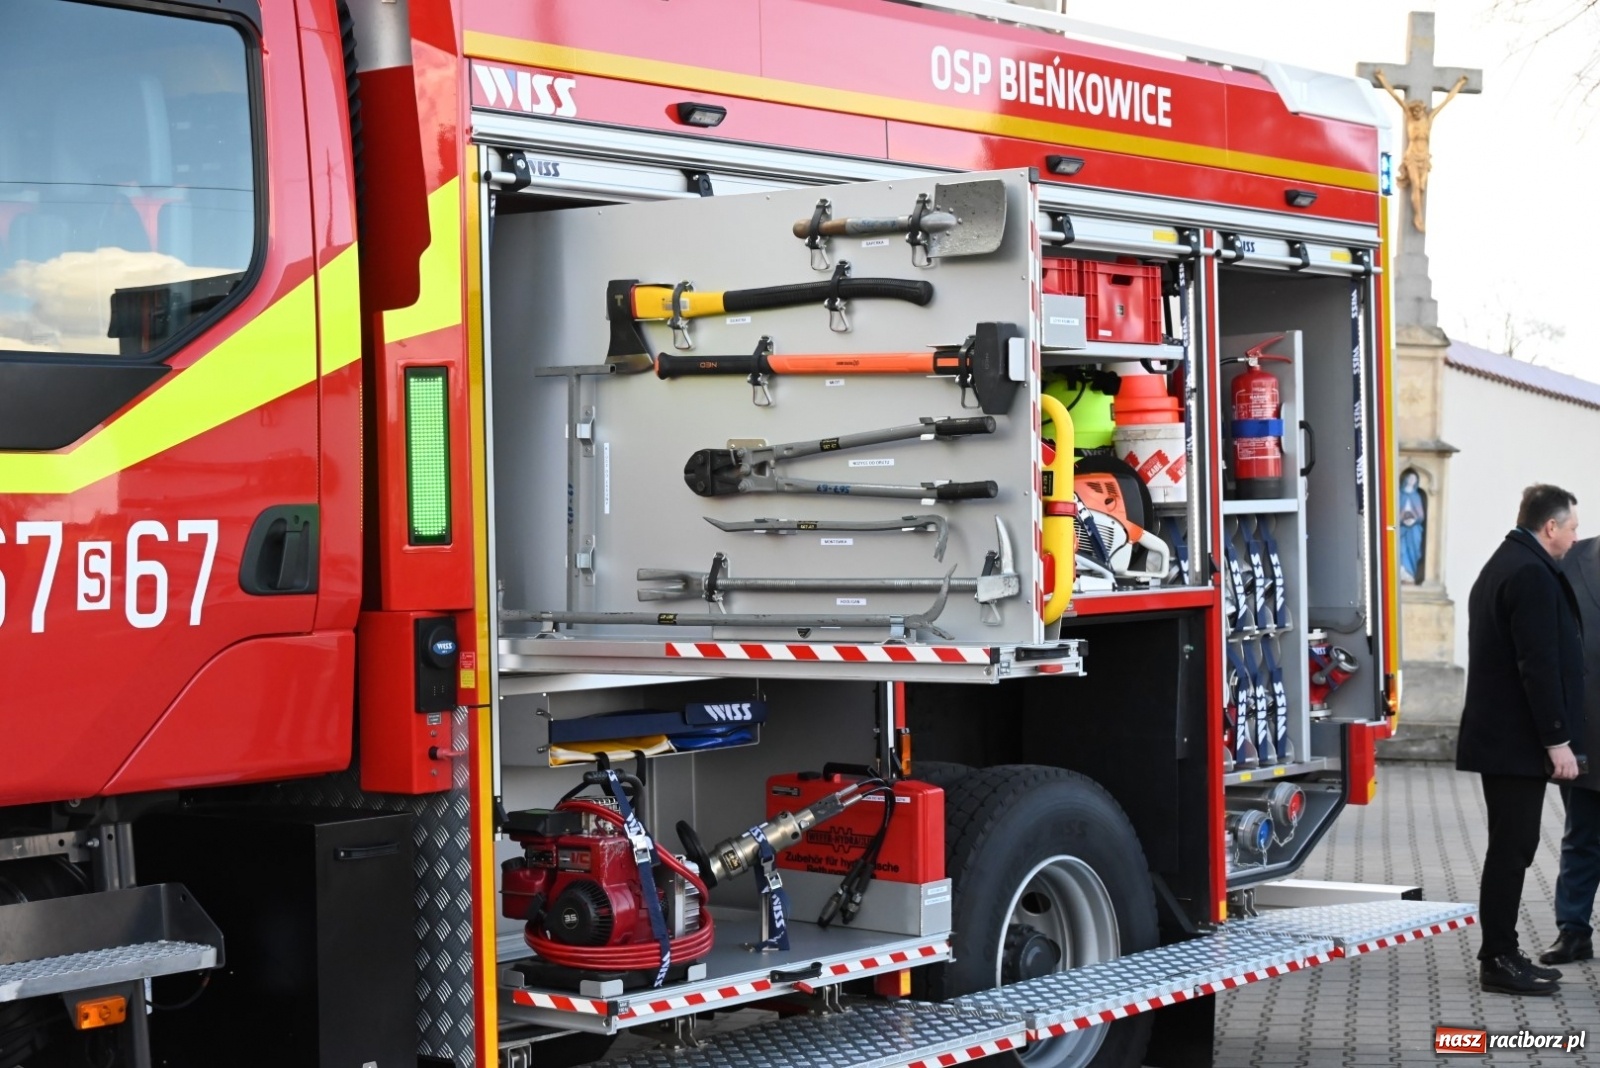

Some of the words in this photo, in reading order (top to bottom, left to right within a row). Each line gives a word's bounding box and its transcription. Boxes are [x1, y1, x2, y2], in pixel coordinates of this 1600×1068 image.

[472, 64, 577, 118] WISS
[931, 46, 992, 95] OSP
[1000, 56, 1172, 128] BIEŃKOWICE
[1242, 240, 1255, 252] ISS
[0, 521, 63, 633] 7
[83, 548, 106, 603] S
[125, 519, 219, 629] 67
[1230, 560, 1248, 620] WISS
[1251, 553, 1265, 612] WISS
[1270, 553, 1284, 612] WISS
[704, 703, 752, 721] WISS
[1237, 690, 1247, 751] WISS
[1256, 685, 1267, 745] WISS
[1273, 682, 1287, 741] WISS
[785, 852, 822, 863] Zubehör
[825, 856, 839, 866] für
